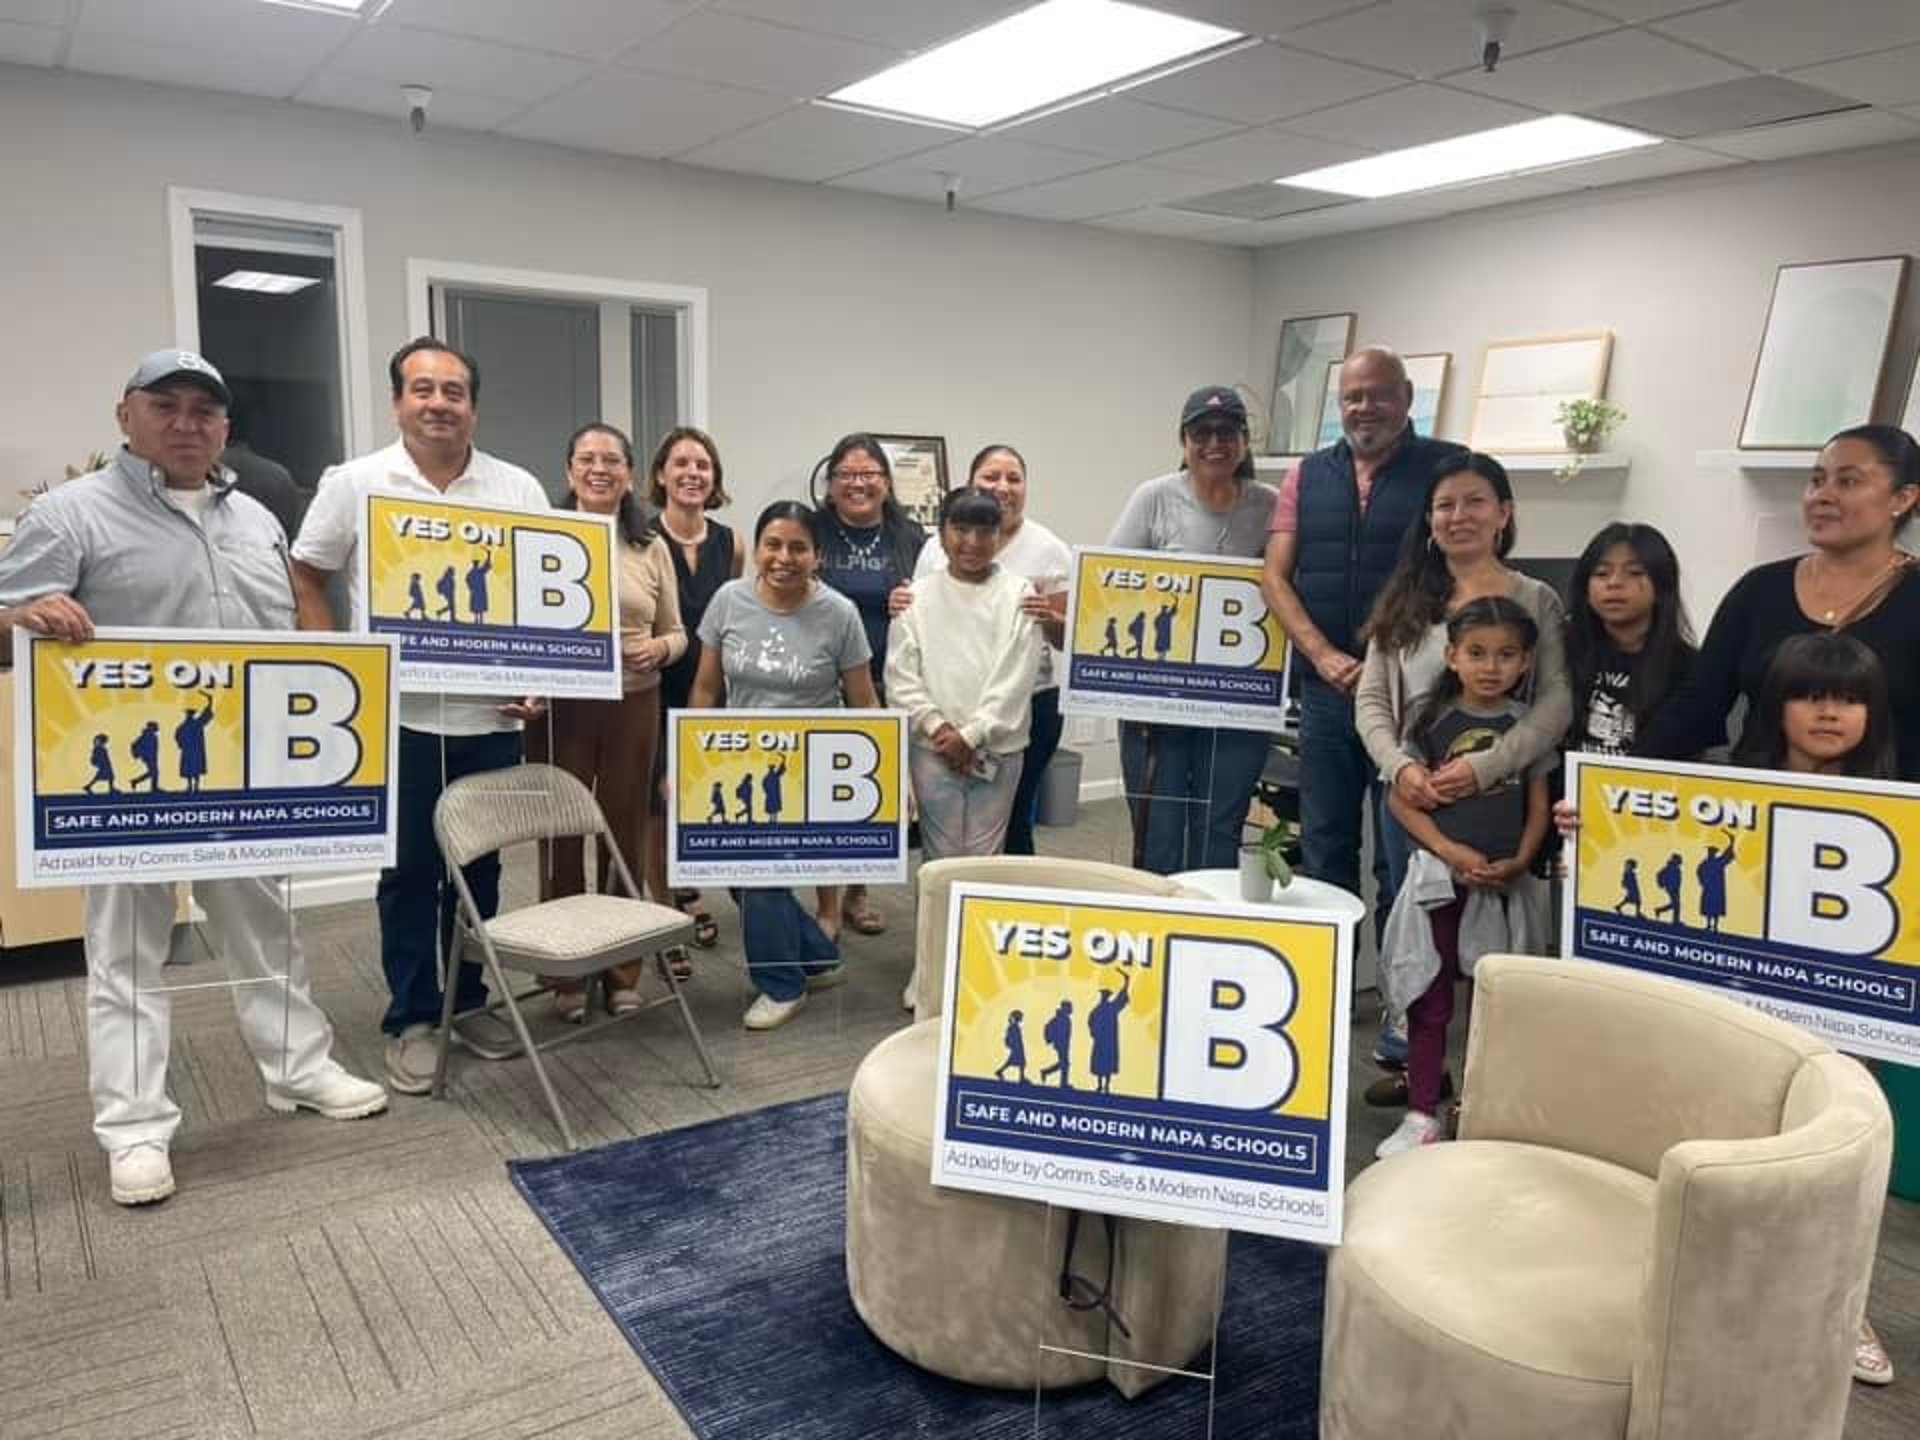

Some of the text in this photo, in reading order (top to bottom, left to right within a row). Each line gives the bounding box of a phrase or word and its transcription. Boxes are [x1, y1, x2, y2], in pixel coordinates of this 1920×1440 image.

[391, 512, 504, 547] YES ON
[513, 527, 594, 631] B
[1097, 568, 1193, 594] YES ON
[1193, 575, 1269, 669] B
[421, 636, 449, 648] AND
[453, 638, 508, 652] MODERN
[511, 639, 545, 654] NAPA
[547, 643, 603, 659] SCHOOLS
[63, 656, 233, 690] YES ON
[1080, 667, 1108, 680] SAFE
[1110, 671, 1134, 682] AND
[1187, 677, 1217, 689] NAPA
[1219, 680, 1272, 694] SCHOOLS
[244, 661, 363, 789] B
[696, 729, 799, 752] YES ON
[804, 730, 882, 822] B
[53, 804, 371, 830] SAFE AND MODERN NAPA SCHOOLS
[1602, 783, 1757, 831] YES ON
[38, 855, 61, 872] Ad
[62, 852, 95, 872] paid
[96, 851, 116, 868] for
[118, 850, 139, 870] by
[689, 836, 718, 848] SAFE
[835, 834, 888, 846] SCHOOLS
[1765, 804, 1901, 957] B
[988, 920, 1153, 968] YES ON
[1589, 928, 1906, 1001] SAFE AND MODERN NAPA SCHOOLS
[1159, 933, 1300, 1112] B
[1814, 1008, 1856, 1036] Napa
[964, 1103, 1308, 1161] SAFE AND MODERN NAPA SCHOOLS
[946, 1149, 1325, 1218] Ad paid for by Comm. Safe & Modern Napa Schools
